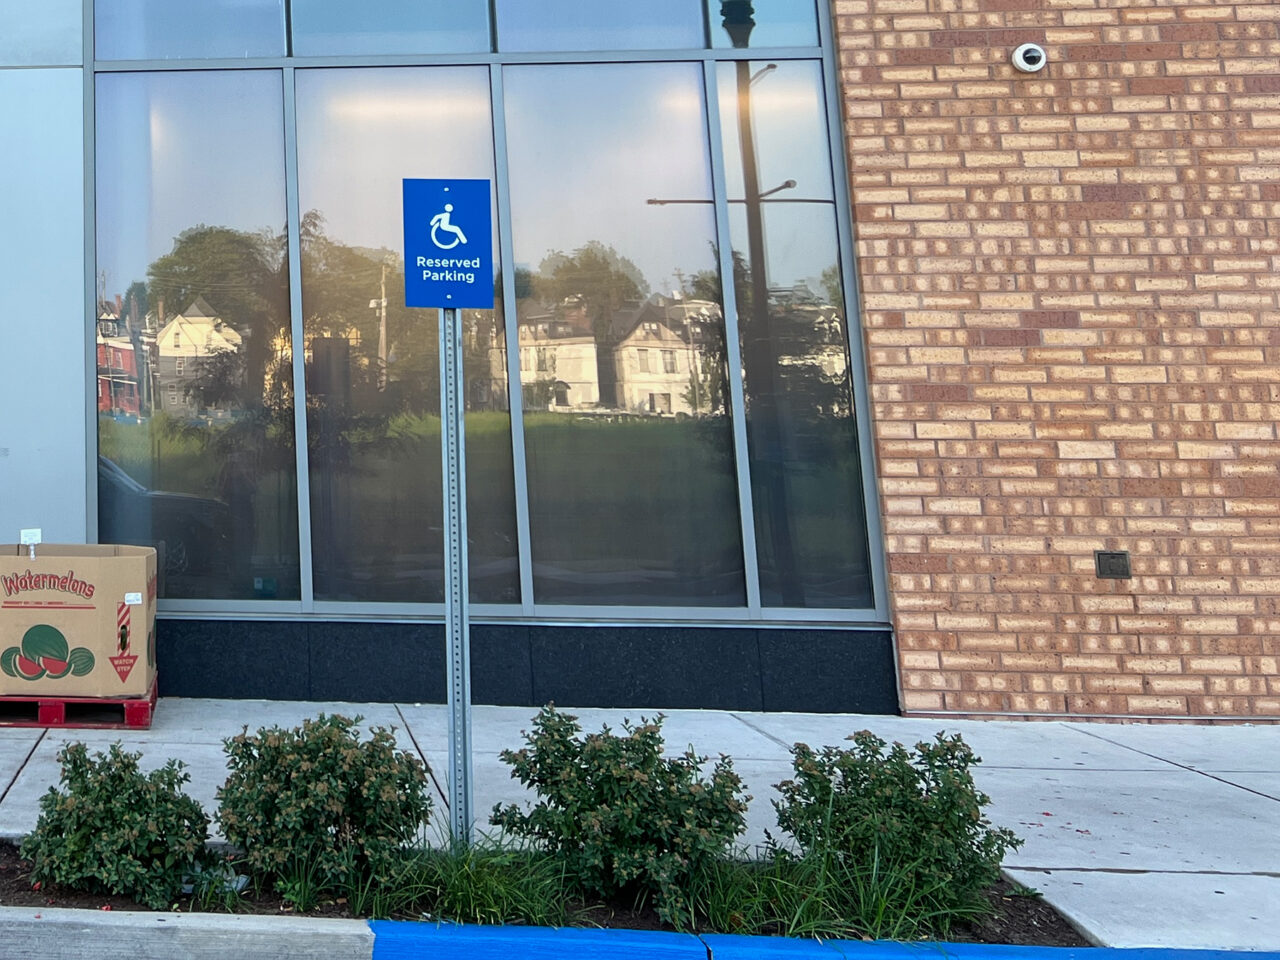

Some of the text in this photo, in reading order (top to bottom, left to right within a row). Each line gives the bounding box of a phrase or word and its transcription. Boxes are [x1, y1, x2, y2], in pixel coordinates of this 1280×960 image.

[416, 256, 480, 268] Reserved
[422, 270, 475, 284] Parking
[1, 569, 95, 599] Watermelons
